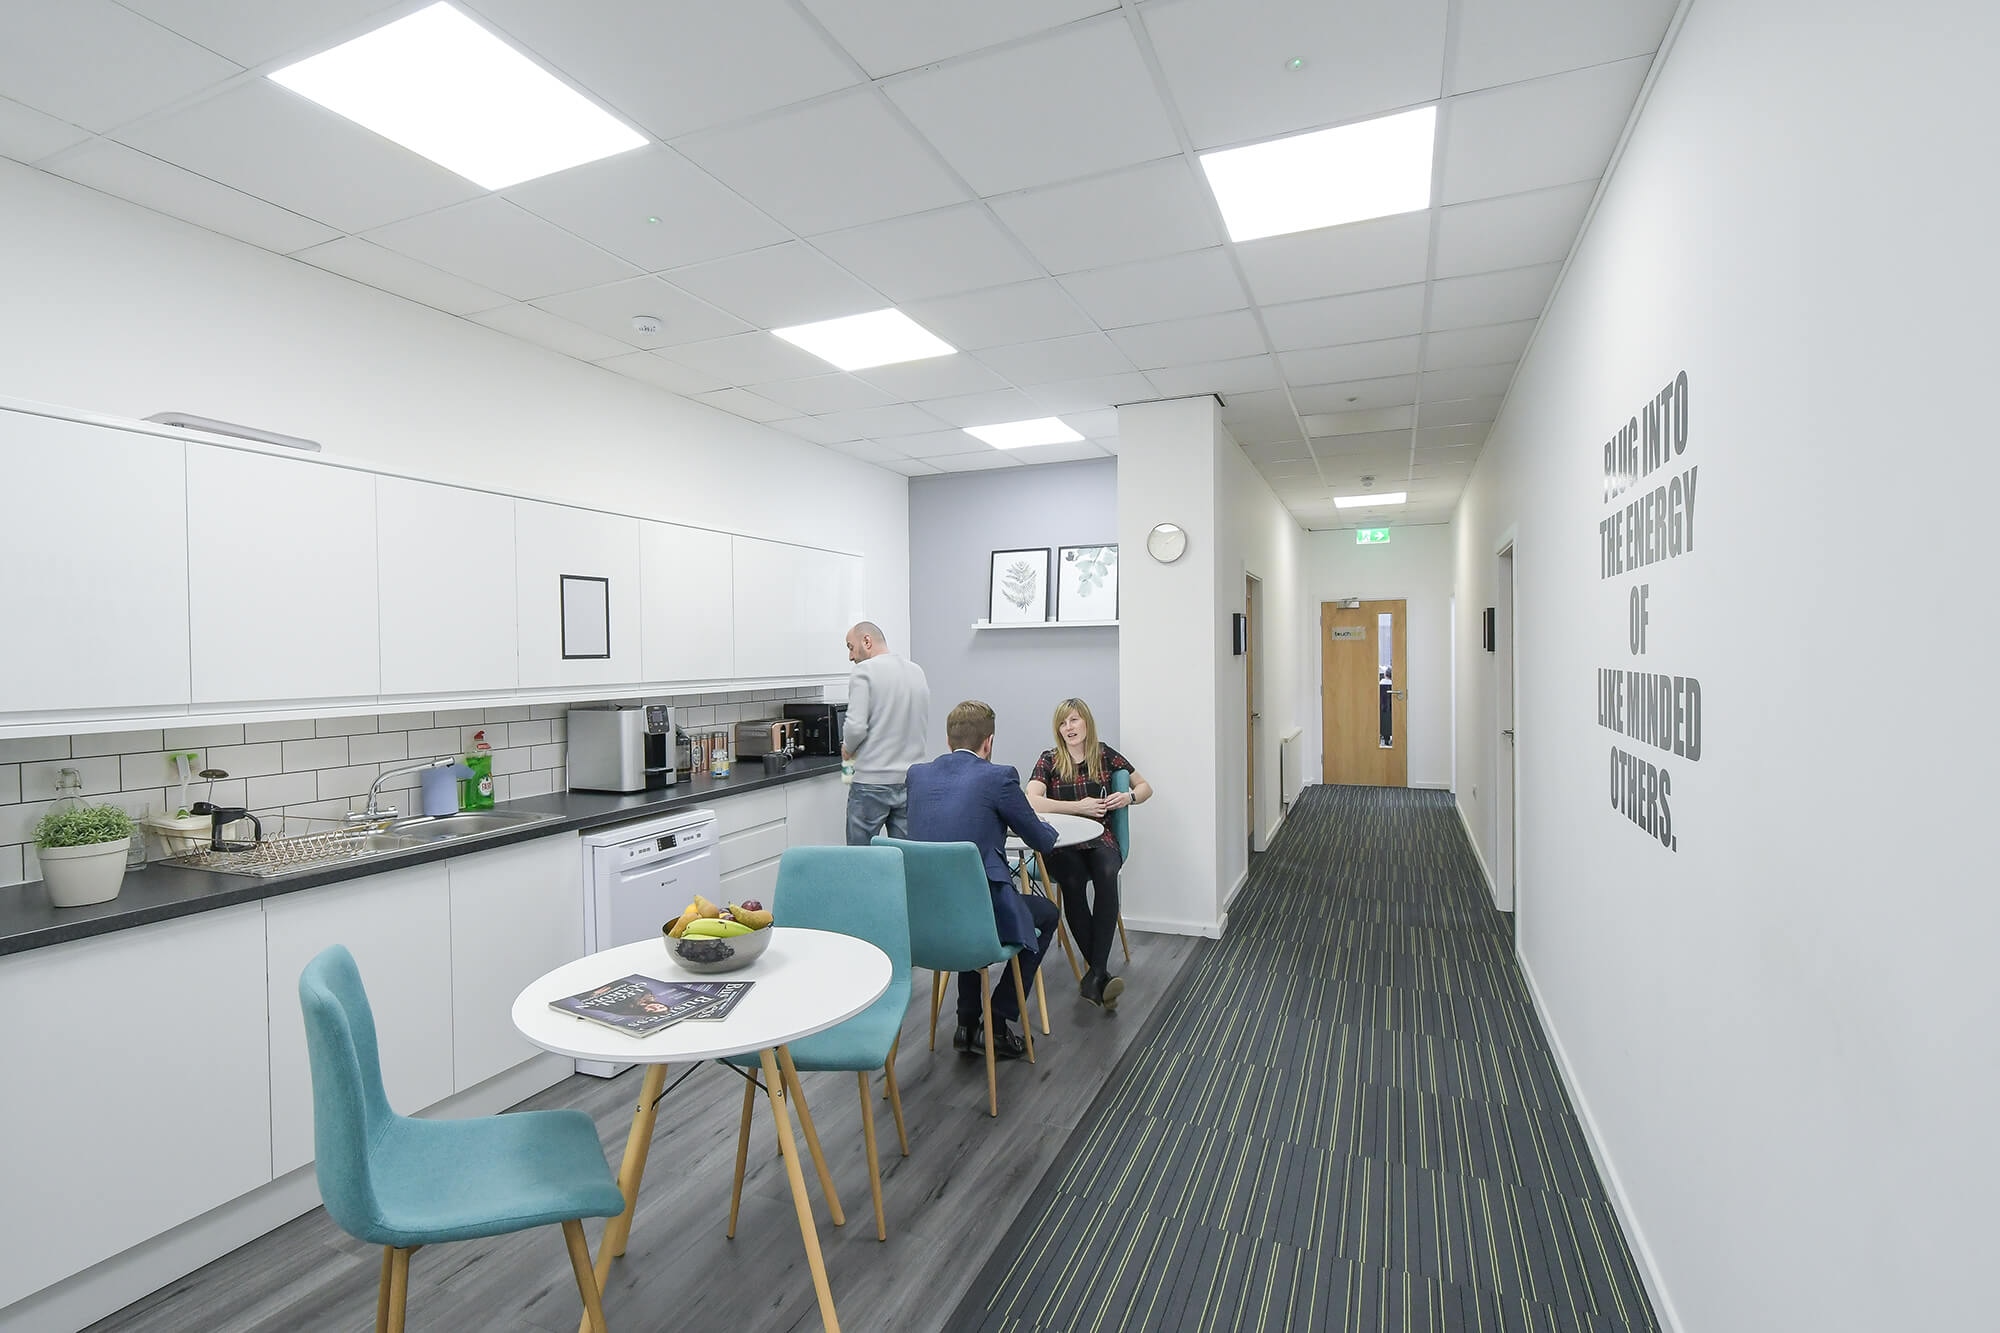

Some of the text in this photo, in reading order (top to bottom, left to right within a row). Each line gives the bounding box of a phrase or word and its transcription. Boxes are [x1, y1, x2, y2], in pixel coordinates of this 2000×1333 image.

[1604, 370, 1689, 504] PLUG INTO
[1599, 465, 1698, 580] THE ENERGY
[1629, 584, 1649, 656] OF
[1598, 667, 1702, 762] LIKE MINDED
[1610, 745, 1677, 853] OTHERS.
